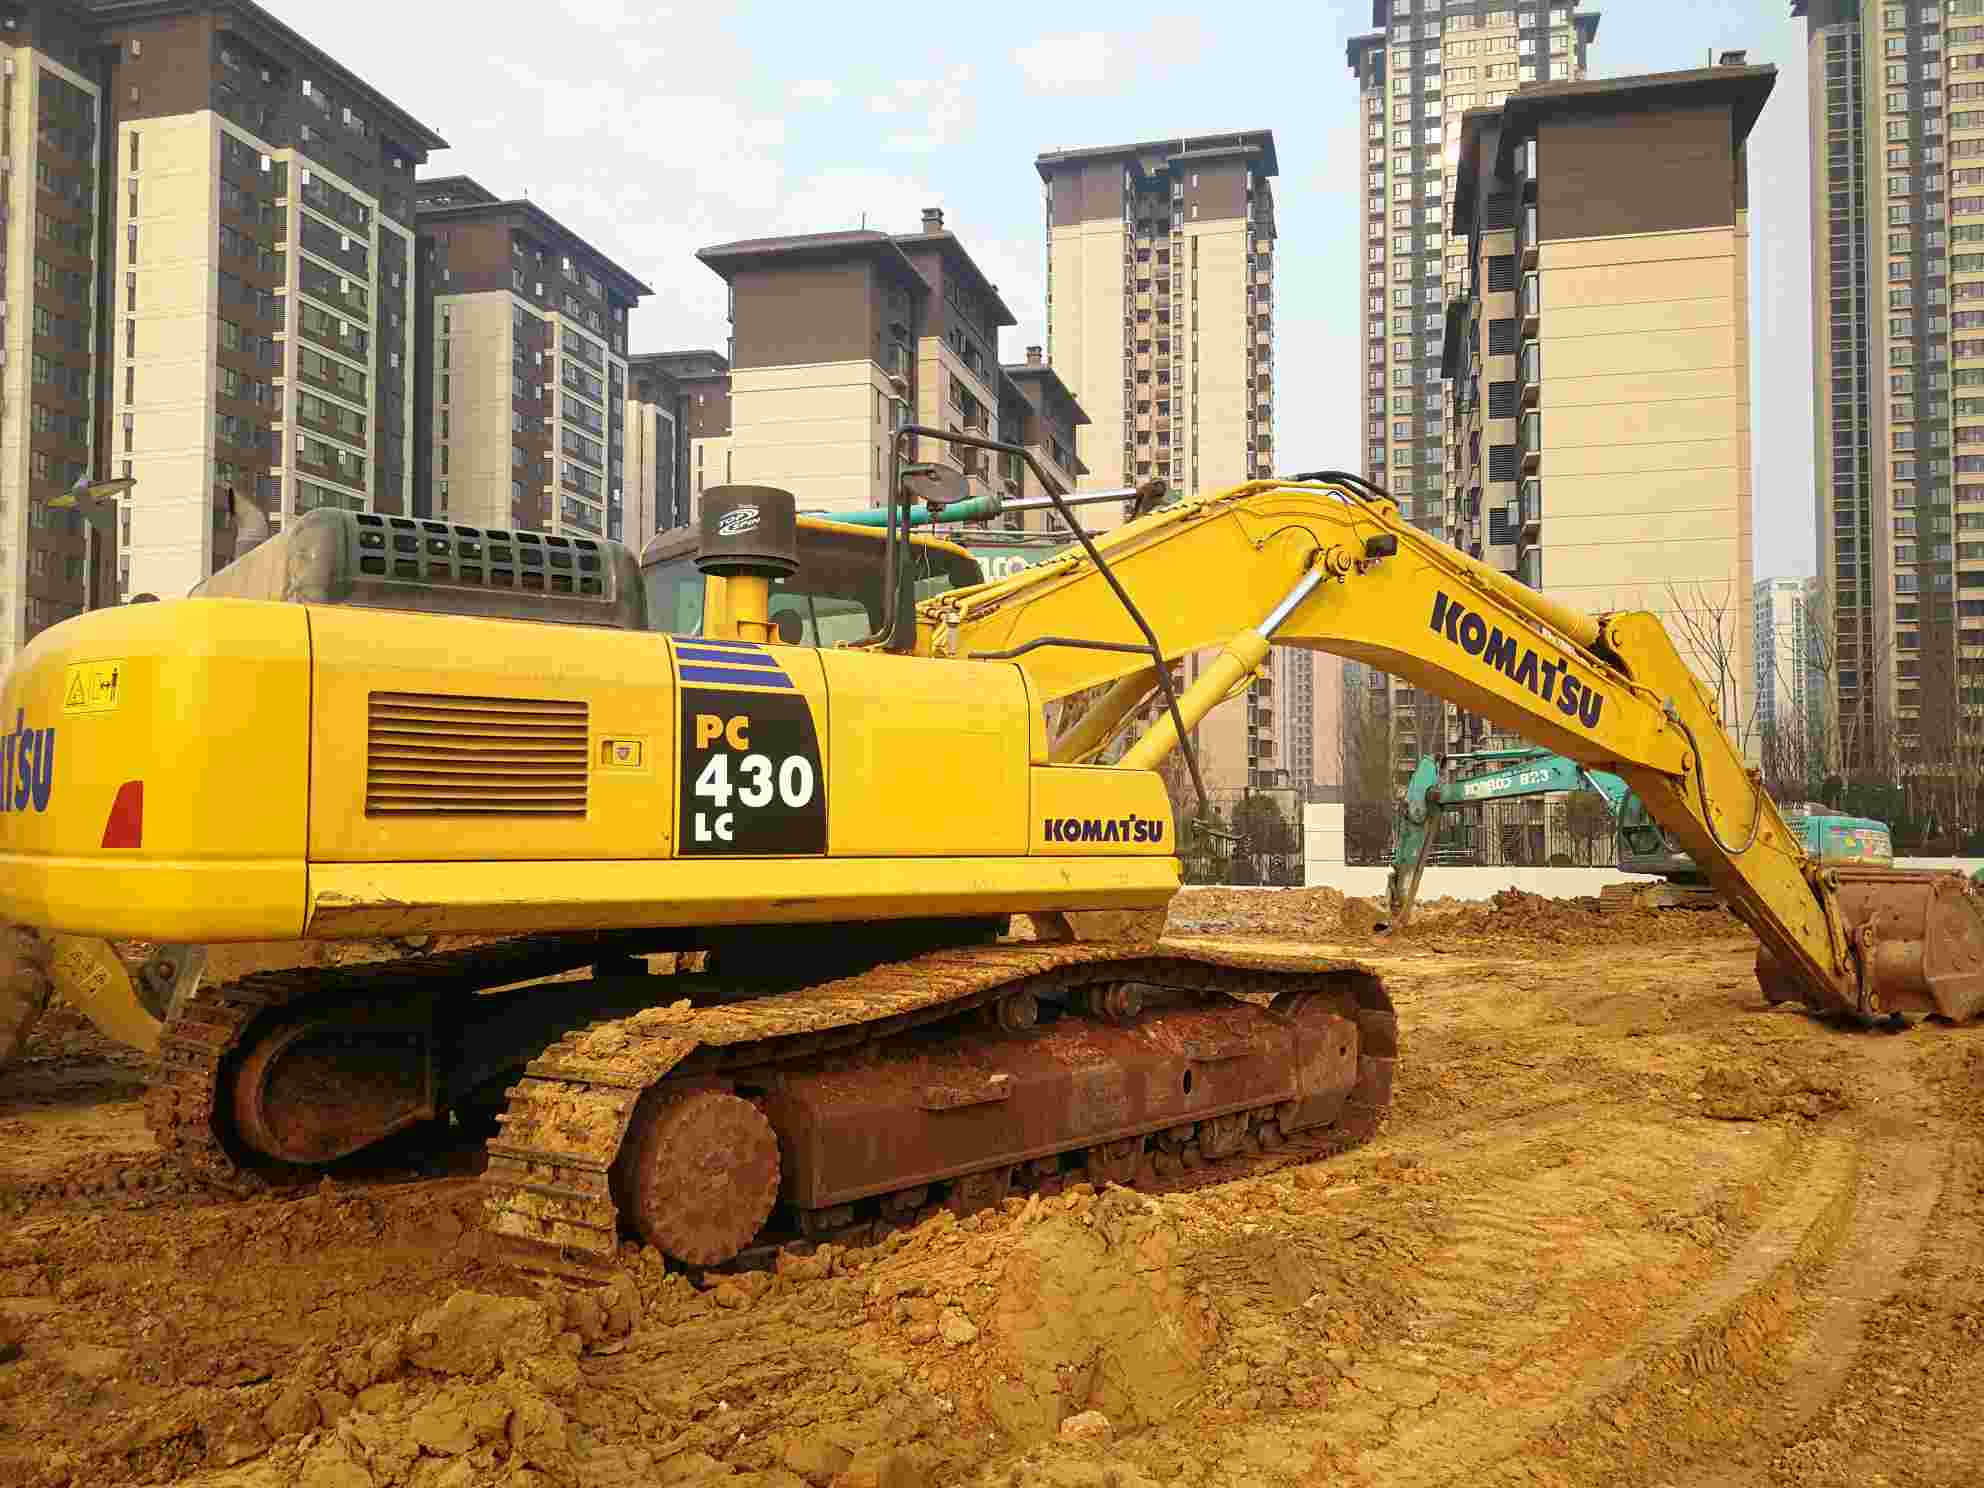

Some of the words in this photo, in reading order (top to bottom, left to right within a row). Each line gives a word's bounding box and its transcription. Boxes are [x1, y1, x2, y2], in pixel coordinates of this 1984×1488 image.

[1430, 590, 1603, 728] KOMATSU
[696, 714, 749, 750] PC
[695, 754, 814, 807] 430
[695, 812, 733, 841] LC
[1044, 814, 1163, 842] KOMATSU
